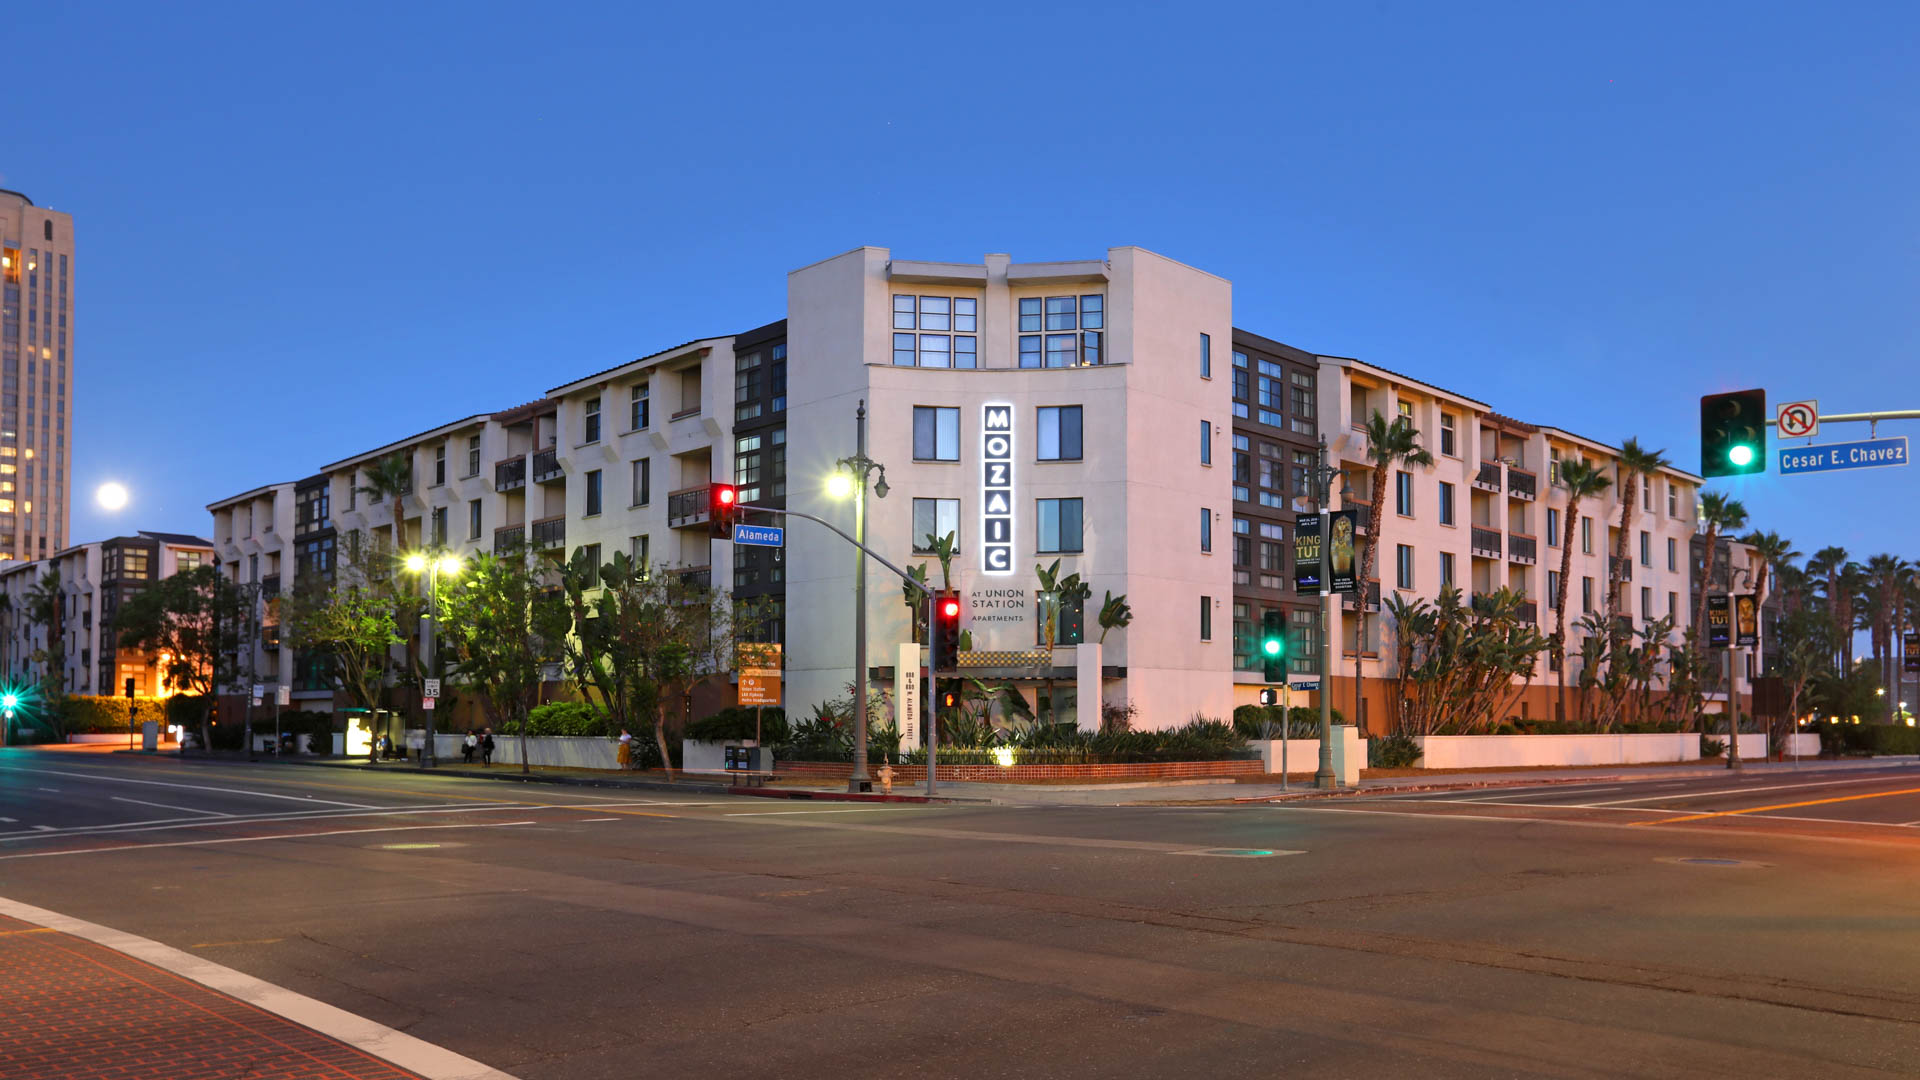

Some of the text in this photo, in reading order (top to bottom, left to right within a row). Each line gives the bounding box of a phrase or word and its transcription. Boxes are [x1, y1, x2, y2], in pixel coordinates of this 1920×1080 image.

[1782, 447, 1904, 469] Cesar E. Chavez
[987, 409, 1009, 568] MOZAIC
[738, 529, 780, 542] Alameda
[1296, 535, 1320, 546] KING
[1296, 545, 1320, 558] TUT
[985, 589, 1024, 598] UNION
[972, 599, 1024, 608] STATION
